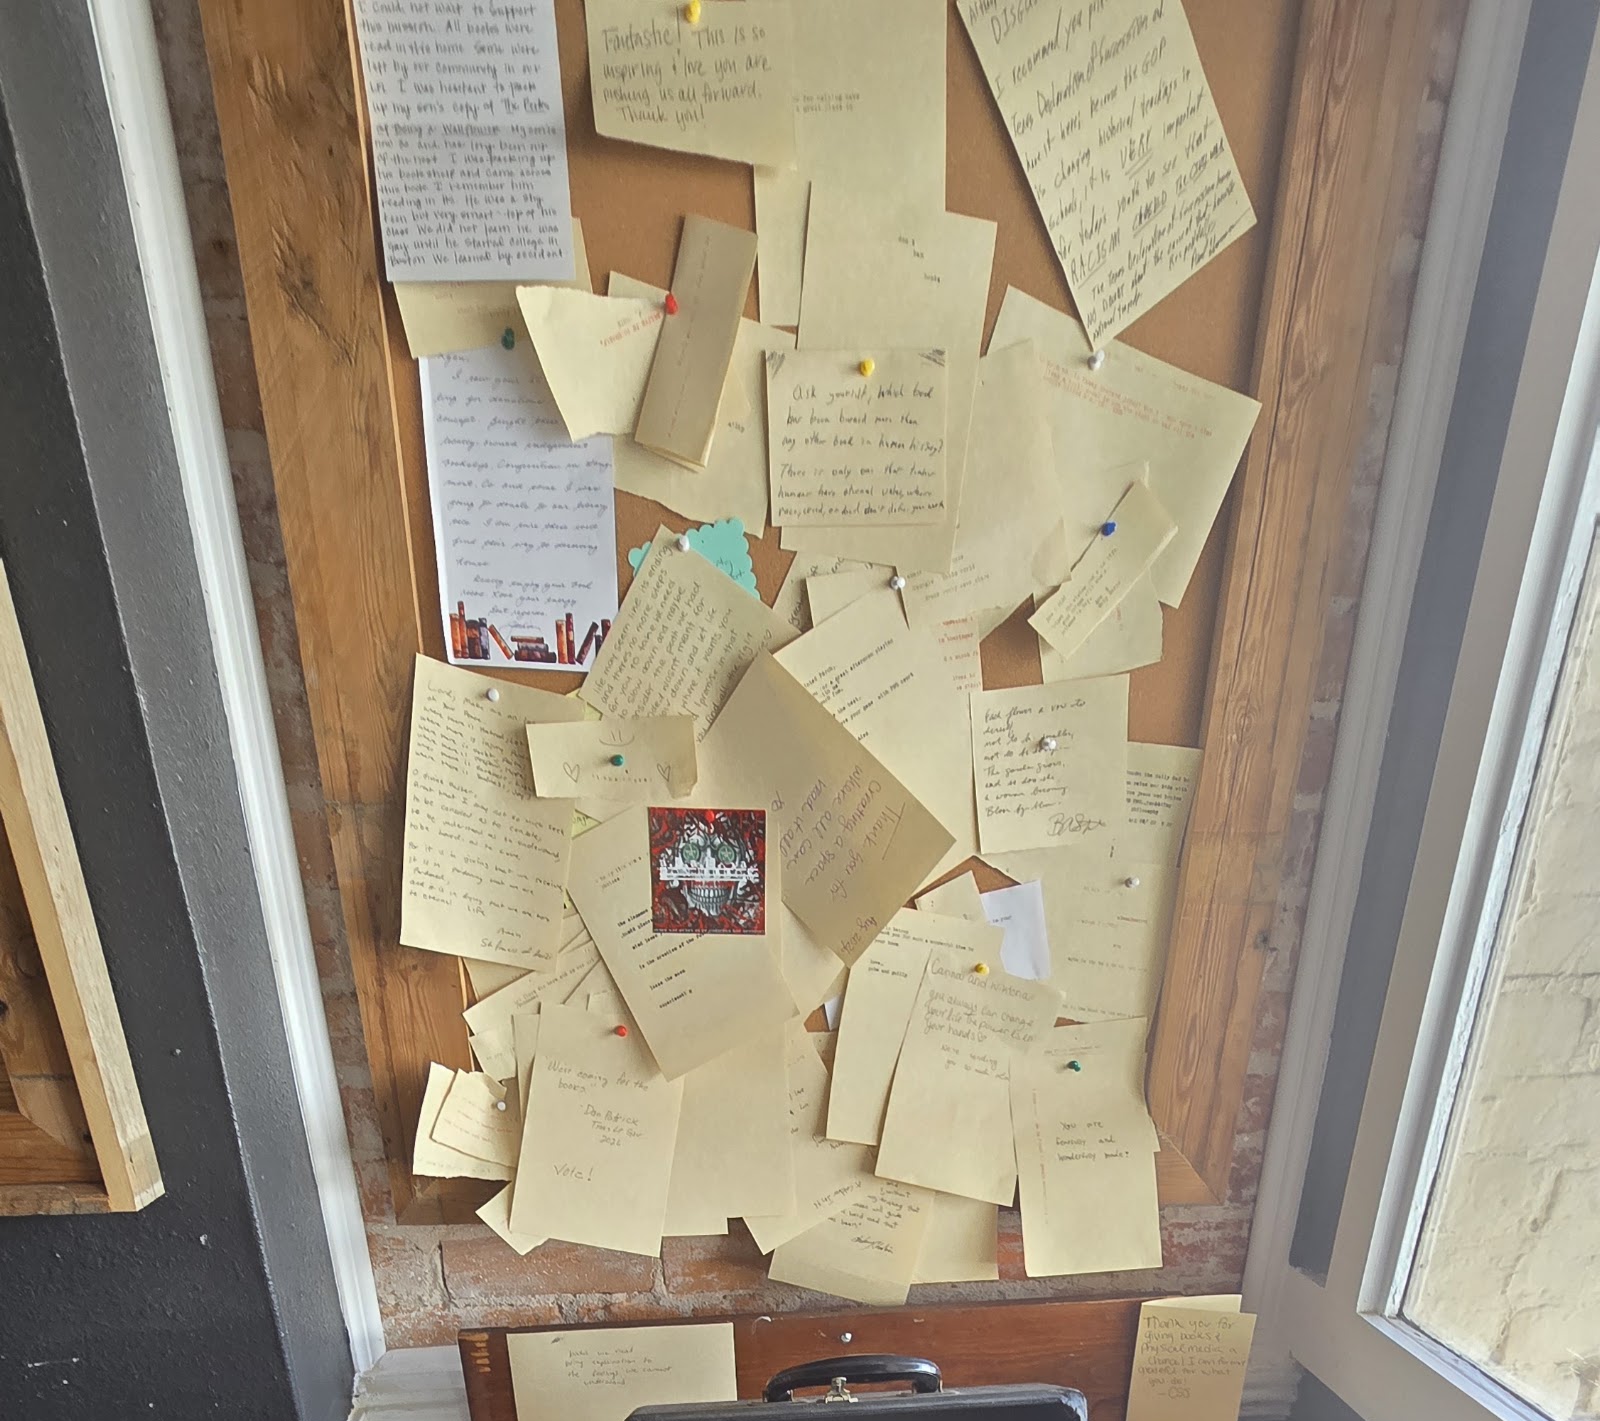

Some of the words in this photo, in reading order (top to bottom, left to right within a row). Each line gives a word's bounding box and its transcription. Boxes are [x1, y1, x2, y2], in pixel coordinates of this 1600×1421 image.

[752, 26, 765, 40] so
[715, 62, 736, 82] you
[616, 105, 667, 123] Thank
[684, 581, 700, 608] had
[657, 624, 668, 643] and
[667, 586, 686, 620] maybe
[678, 622, 695, 652] meant
[693, 598, 704, 616] for
[601, 684, 613, 704] and
[637, 604, 652, 632] more
[604, 653, 618, 676] may
[614, 624, 630, 652] seem
[724, 628, 737, 653] that
[671, 668, 688, 698] down
[688, 645, 698, 666] and
[608, 697, 618, 712] for
[620, 676, 632, 696] you
[833, 765, 862, 805] where
[838, 780, 881, 832] creating
[789, 816, 803, 832] it
[812, 811, 831, 838] all
[780, 829, 794, 857] all
[834, 836, 843, 846] a
[805, 850, 835, 885] space
[845, 849, 864, 875] you
[830, 878, 847, 902] for
[553, 1163, 594, 1181] Vote!
[1143, 1315, 1184, 1329] Thank
[1189, 1320, 1211, 1332] you
[1218, 1317, 1233, 1330] for
